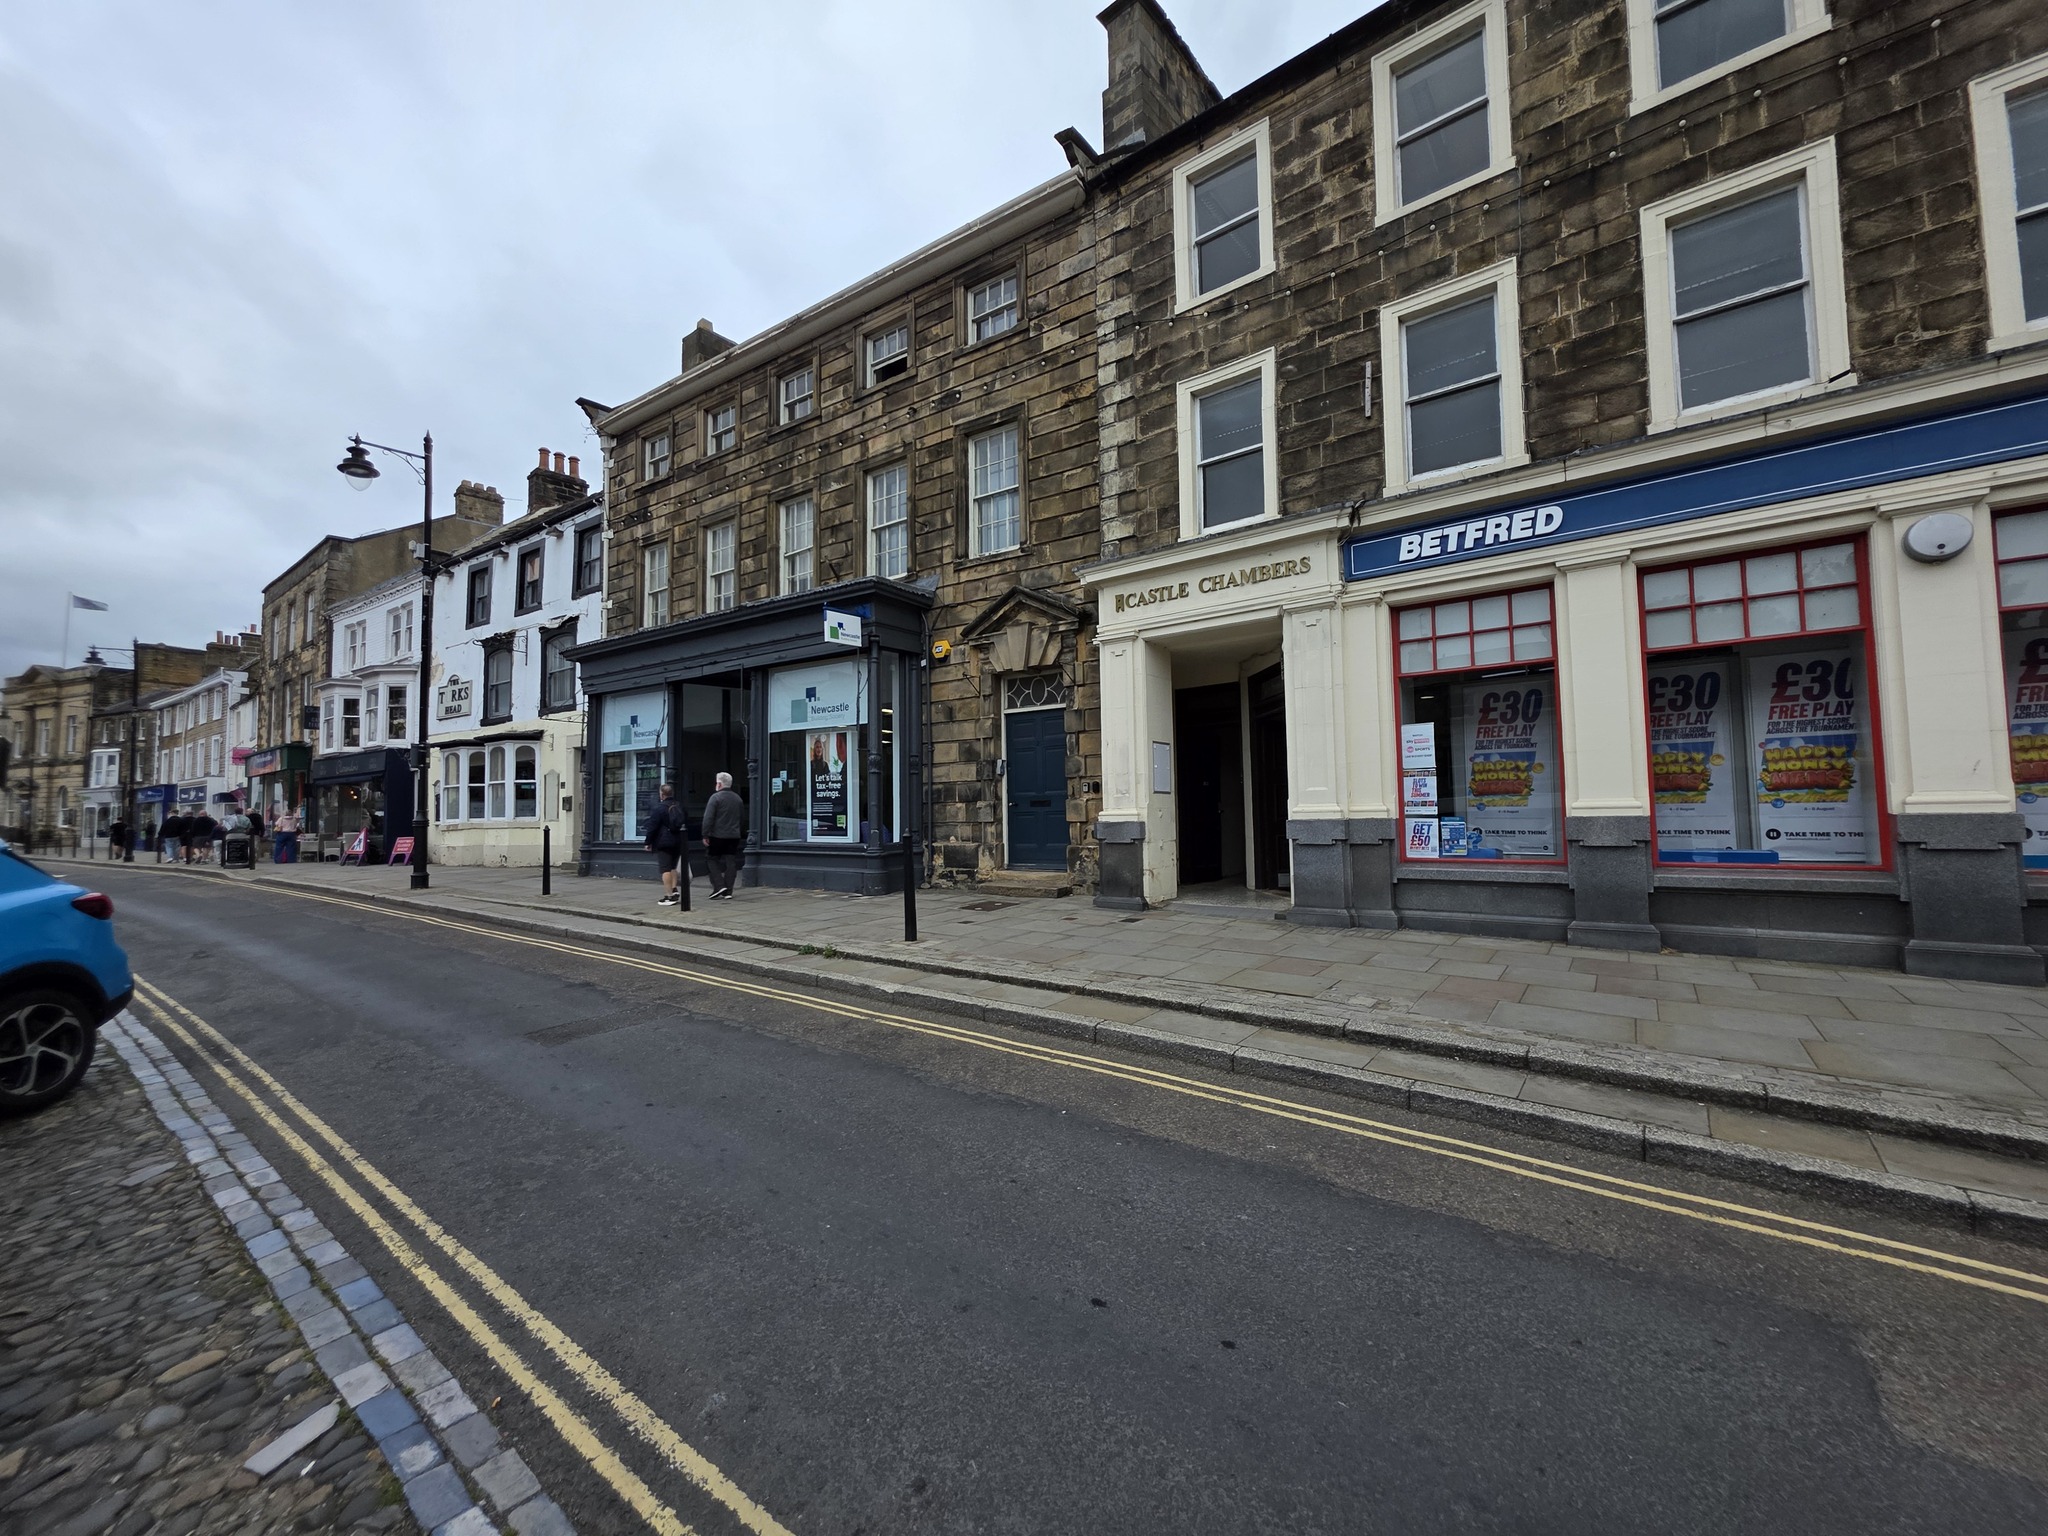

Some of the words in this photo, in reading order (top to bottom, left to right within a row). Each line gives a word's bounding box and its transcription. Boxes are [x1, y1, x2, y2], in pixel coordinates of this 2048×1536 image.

[1399, 505, 1564, 562] BETFRED
[1125, 582, 1190, 609] CASTLE
[1198, 556, 1312, 594] CHAMBERS
[445, 704, 462, 715] HEAD
[811, 702, 849, 714] Newcastle
[1478, 688, 1543, 726] £30
[1768, 703, 1809, 720] FREE
[1812, 700, 1854, 718] PLAY
[1650, 712, 1674, 728] REE
[1676, 711, 1713, 726] PLAY
[1796, 718, 1825, 727] HIGHEST
[1827, 716, 1851, 725] SCORE
[1476, 725, 1505, 739] FREE
[1506, 724, 1536, 737] PLAY
[1652, 752, 1705, 764] APPY
[1764, 746, 1847, 760] HAPPY
[1473, 760, 1529, 772] HAPPY
[1654, 764, 1705, 774] ONEY
[1767, 759, 1847, 772] MONEY
[815, 774, 830, 782] Let's
[830, 774, 843, 782] talk
[1474, 771, 1529, 781] MONEY
[816, 782, 841, 790] tax-free
[816, 790, 841, 798] savings.
[1413, 823, 1433, 834] GET
[1410, 835, 1430, 846] £50
